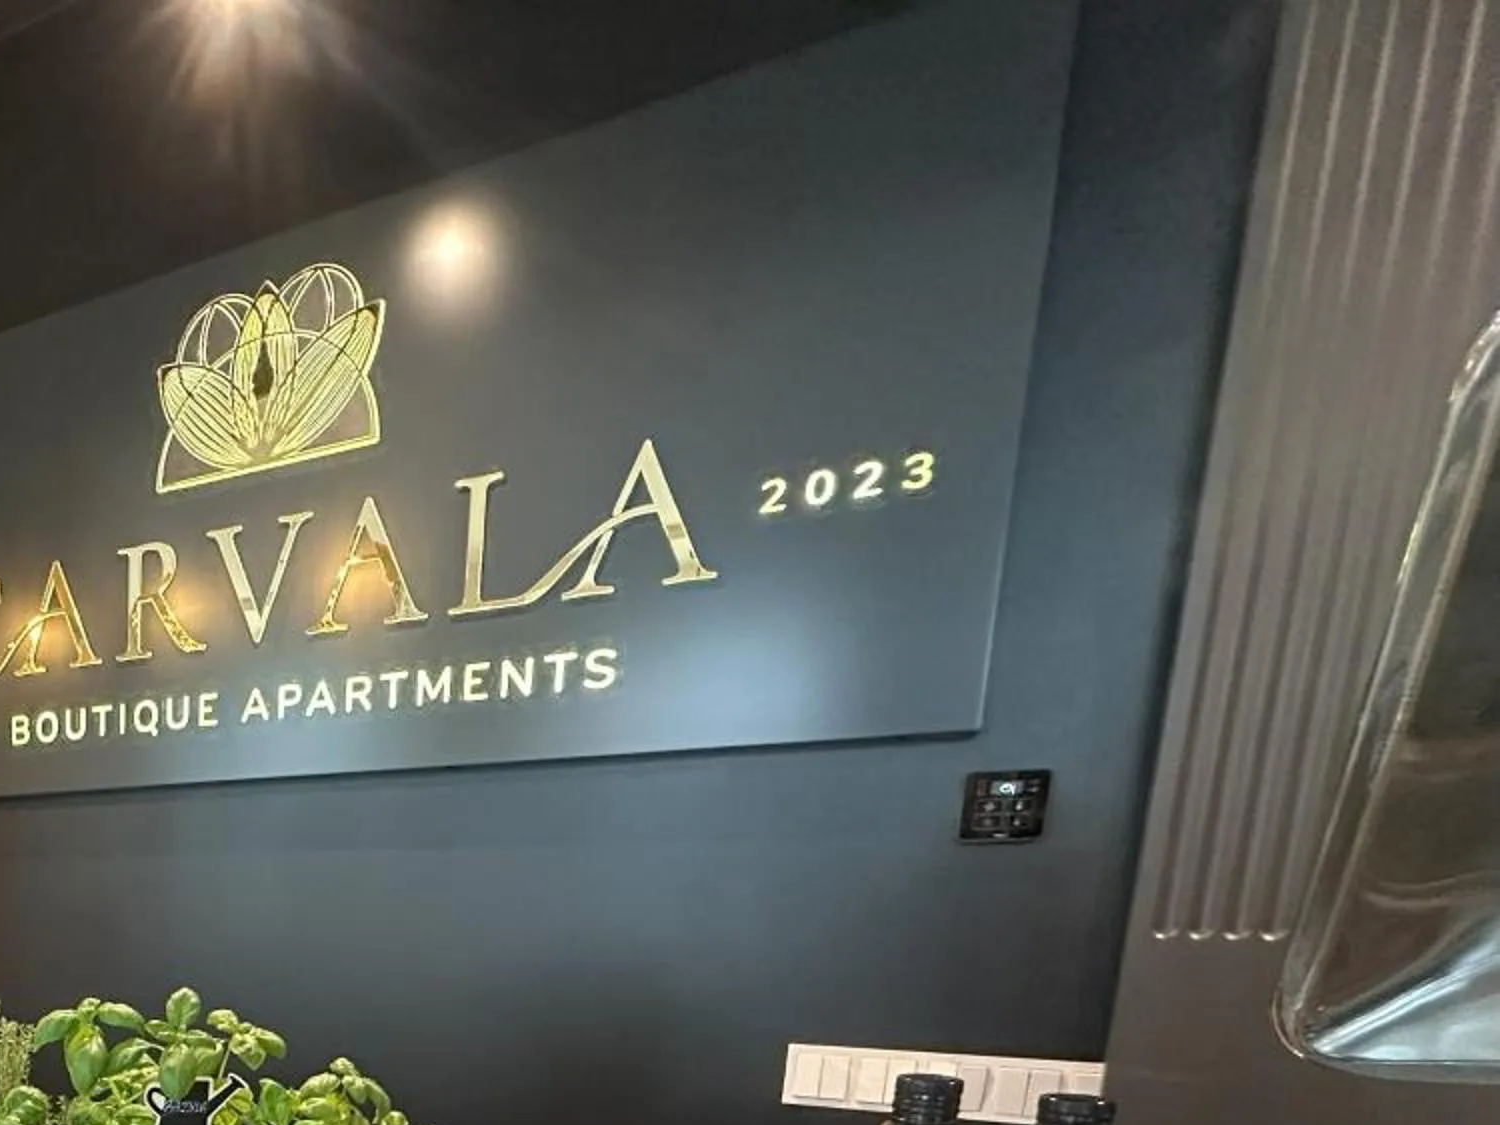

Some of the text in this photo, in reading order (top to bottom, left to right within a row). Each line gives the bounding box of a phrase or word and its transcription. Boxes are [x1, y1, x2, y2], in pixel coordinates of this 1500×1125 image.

[758, 451, 936, 516] 2023
[10, 647, 622, 748] BOUTIQUE APARTMENTS
